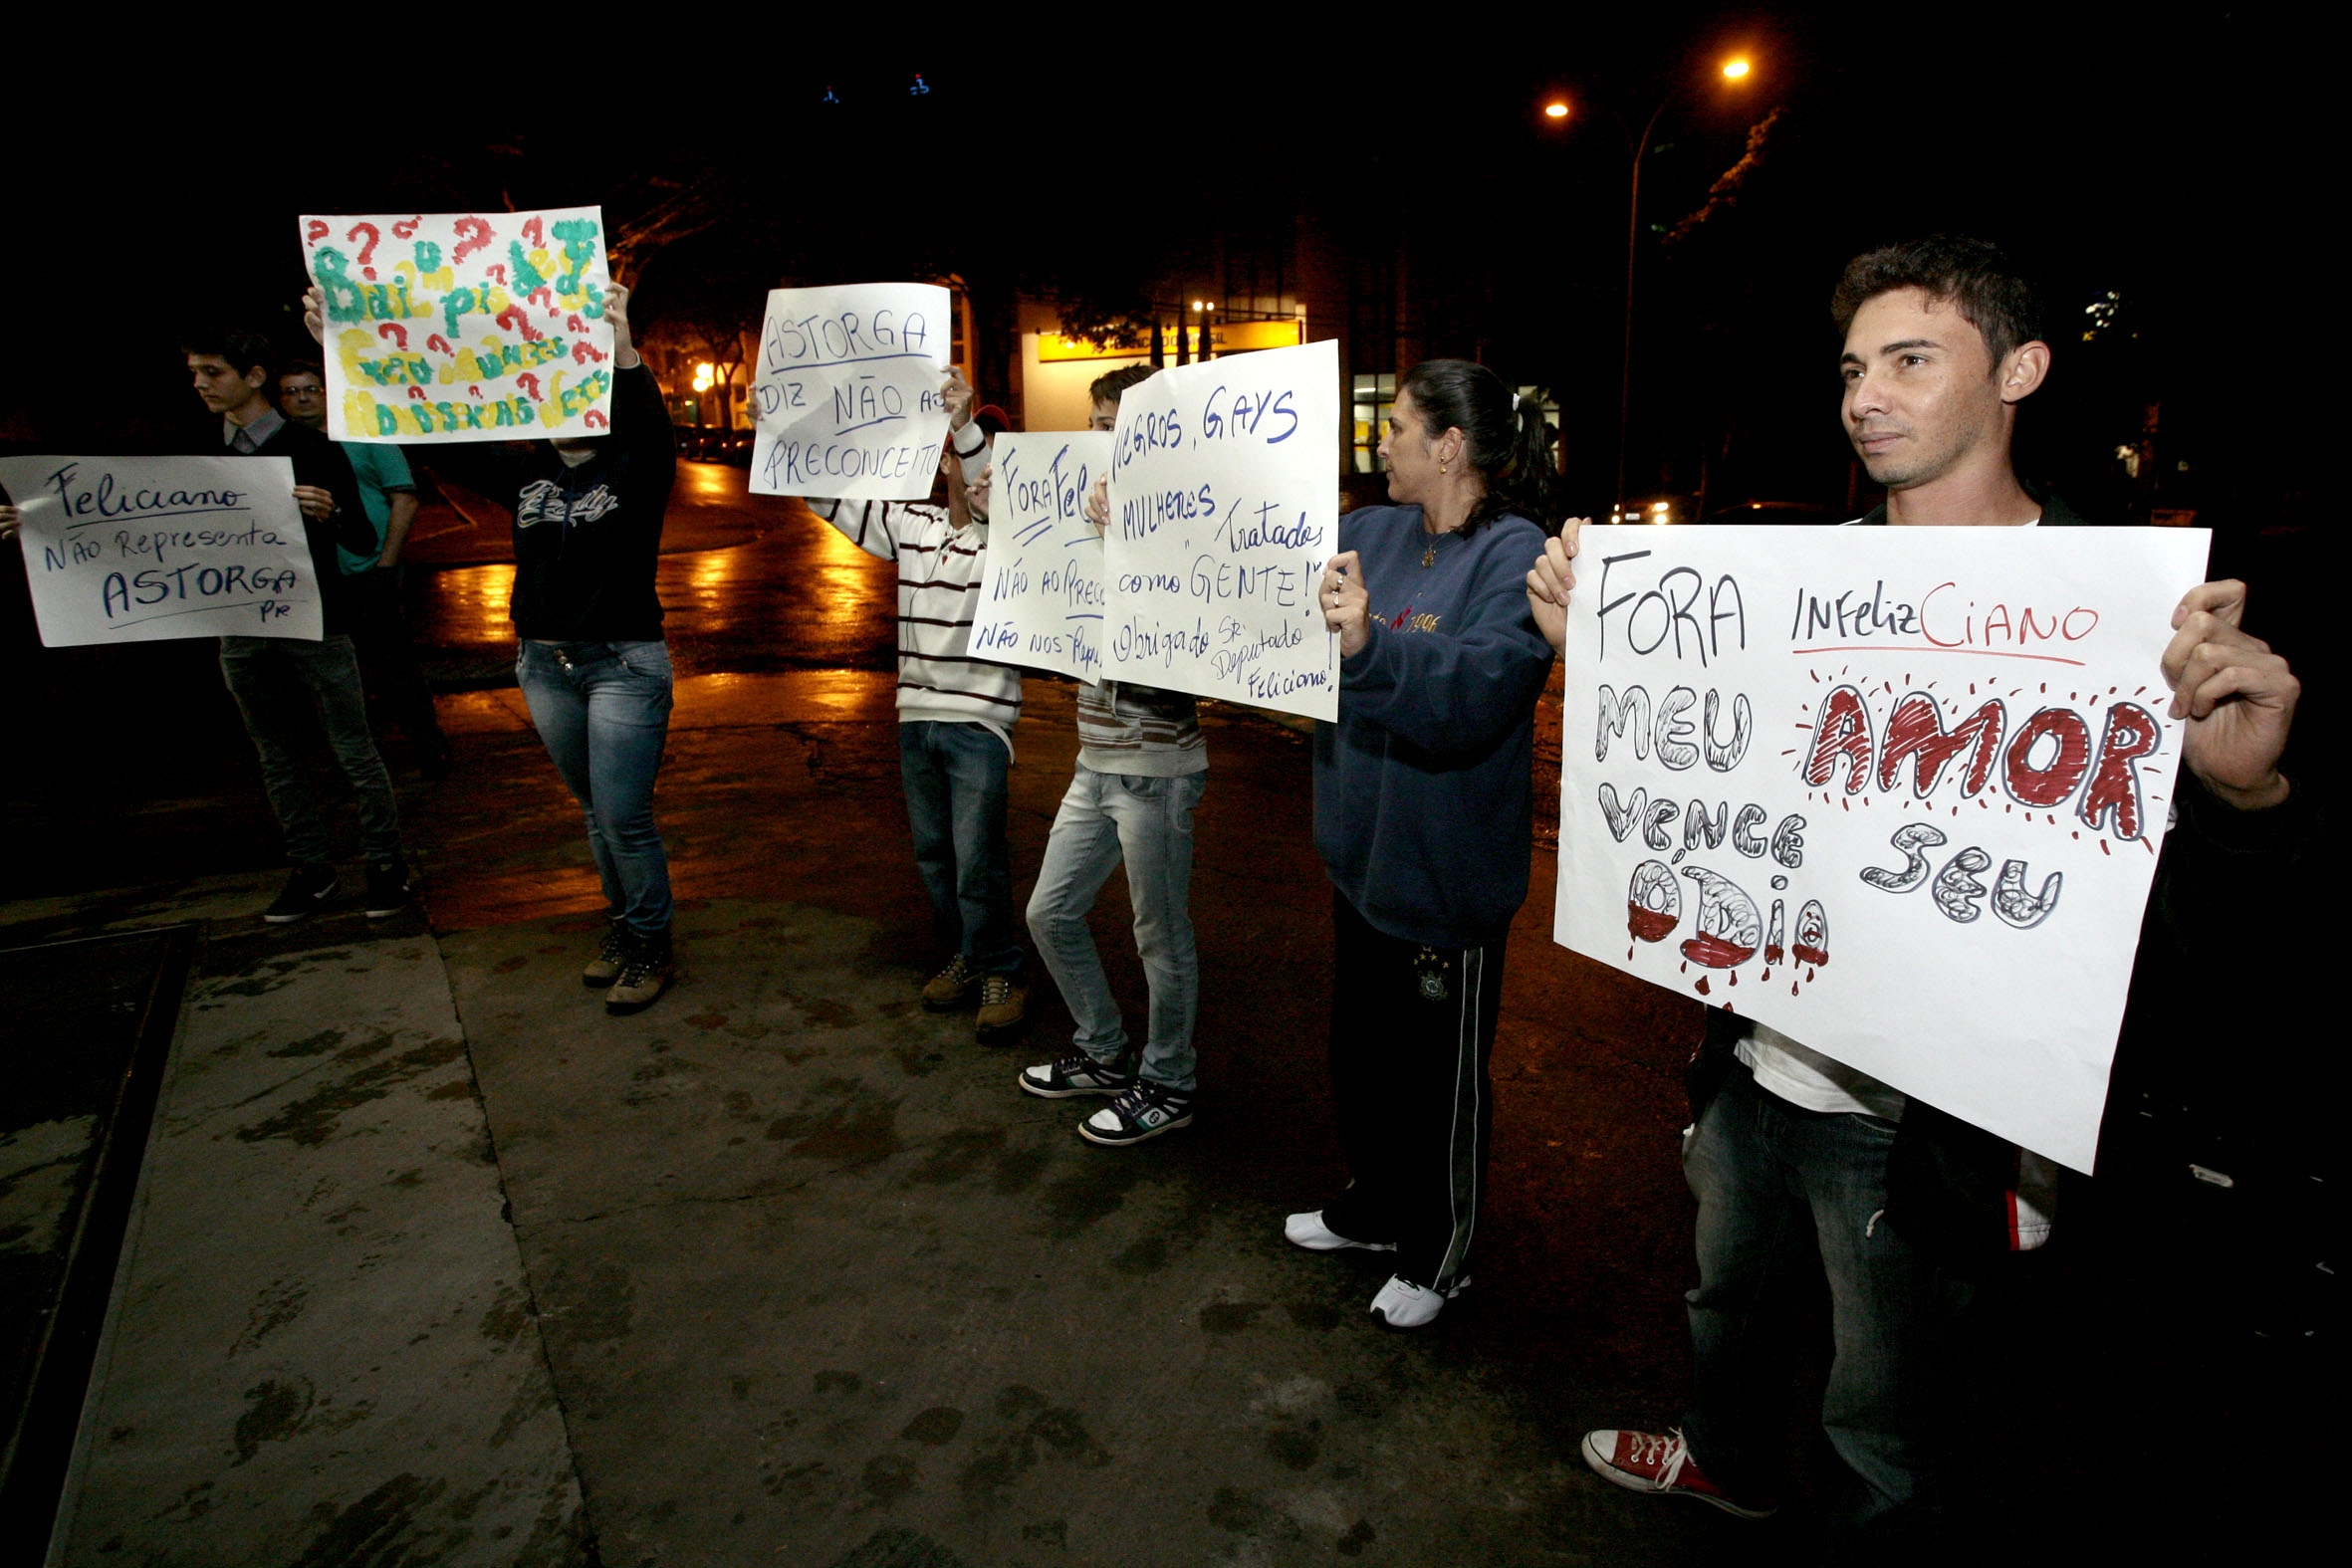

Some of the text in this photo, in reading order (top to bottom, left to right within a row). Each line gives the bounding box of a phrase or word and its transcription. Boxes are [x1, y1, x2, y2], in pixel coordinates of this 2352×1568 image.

[765, 310, 927, 366] ASTORGA
[760, 379, 807, 415] DIZ
[834, 376, 903, 424] NÃO
[1203, 385, 1298, 444] GAYS
[45, 462, 247, 518] Feliciano
[764, 439, 940, 490] PRECONCEITO
[1002, 444, 1093, 524] FORA Fel
[1123, 484, 1215, 542] MULHERES
[1214, 498, 1323, 553] Tratados
[45, 519, 287, 571] NÃO Representa
[104, 562, 295, 618] ASTORGA
[1042, 569, 1058, 595] AO
[1119, 573, 1180, 593] como
[1597, 550, 1745, 668] FORA
[976, 621, 1019, 650] NÃO
[1030, 633, 1062, 654] NOS
[1113, 615, 1209, 669] Obrigado
[1211, 618, 1302, 684] Deputado
[1595, 683, 2163, 841] MEU AMOR
[1597, 783, 2063, 930] VENCE SEU
